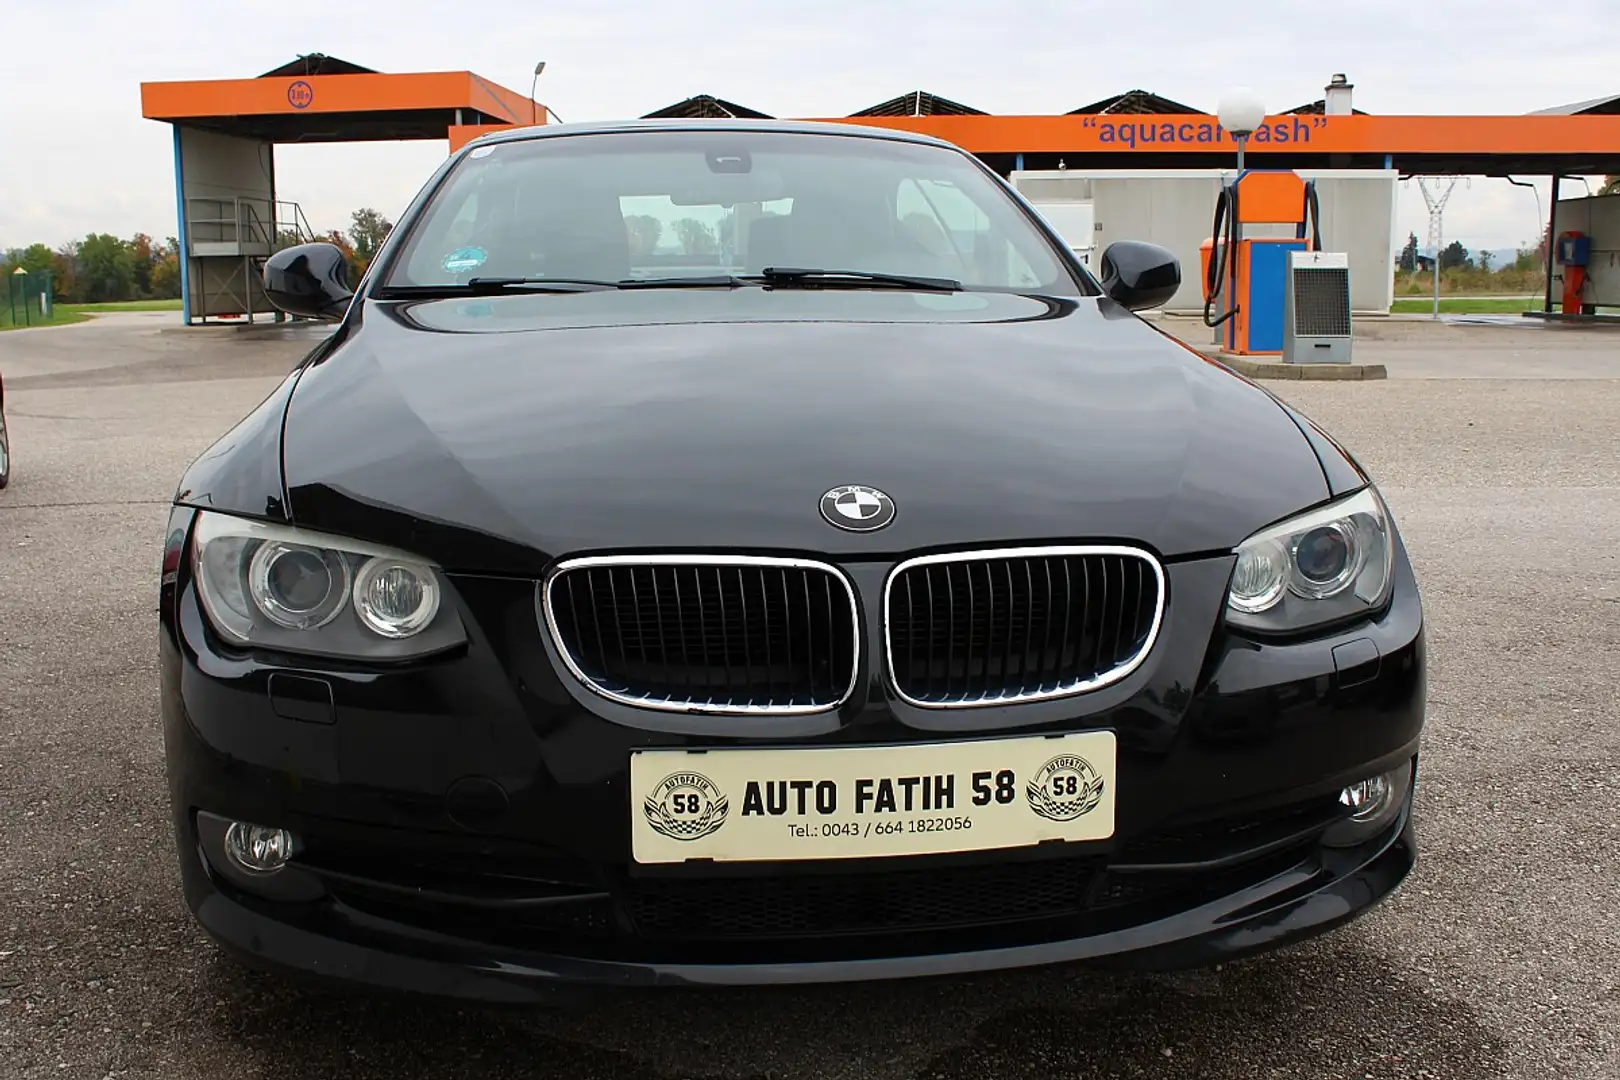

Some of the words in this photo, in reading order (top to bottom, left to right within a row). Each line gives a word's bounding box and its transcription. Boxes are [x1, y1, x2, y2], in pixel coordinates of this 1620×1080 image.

[1082, 117, 1328, 148] “aquacarash”
[741, 780, 837, 816] AUTO
[855, 774, 955, 814] FATIH
[972, 769, 1015, 806] 58
[1053, 776, 1078, 796] 58
[673, 794, 700, 814] 58
[788, 823, 818, 838] Tel.:
[821, 823, 860, 837] 0043
[875, 821, 903, 835] 664
[908, 816, 972, 834] 1822056
